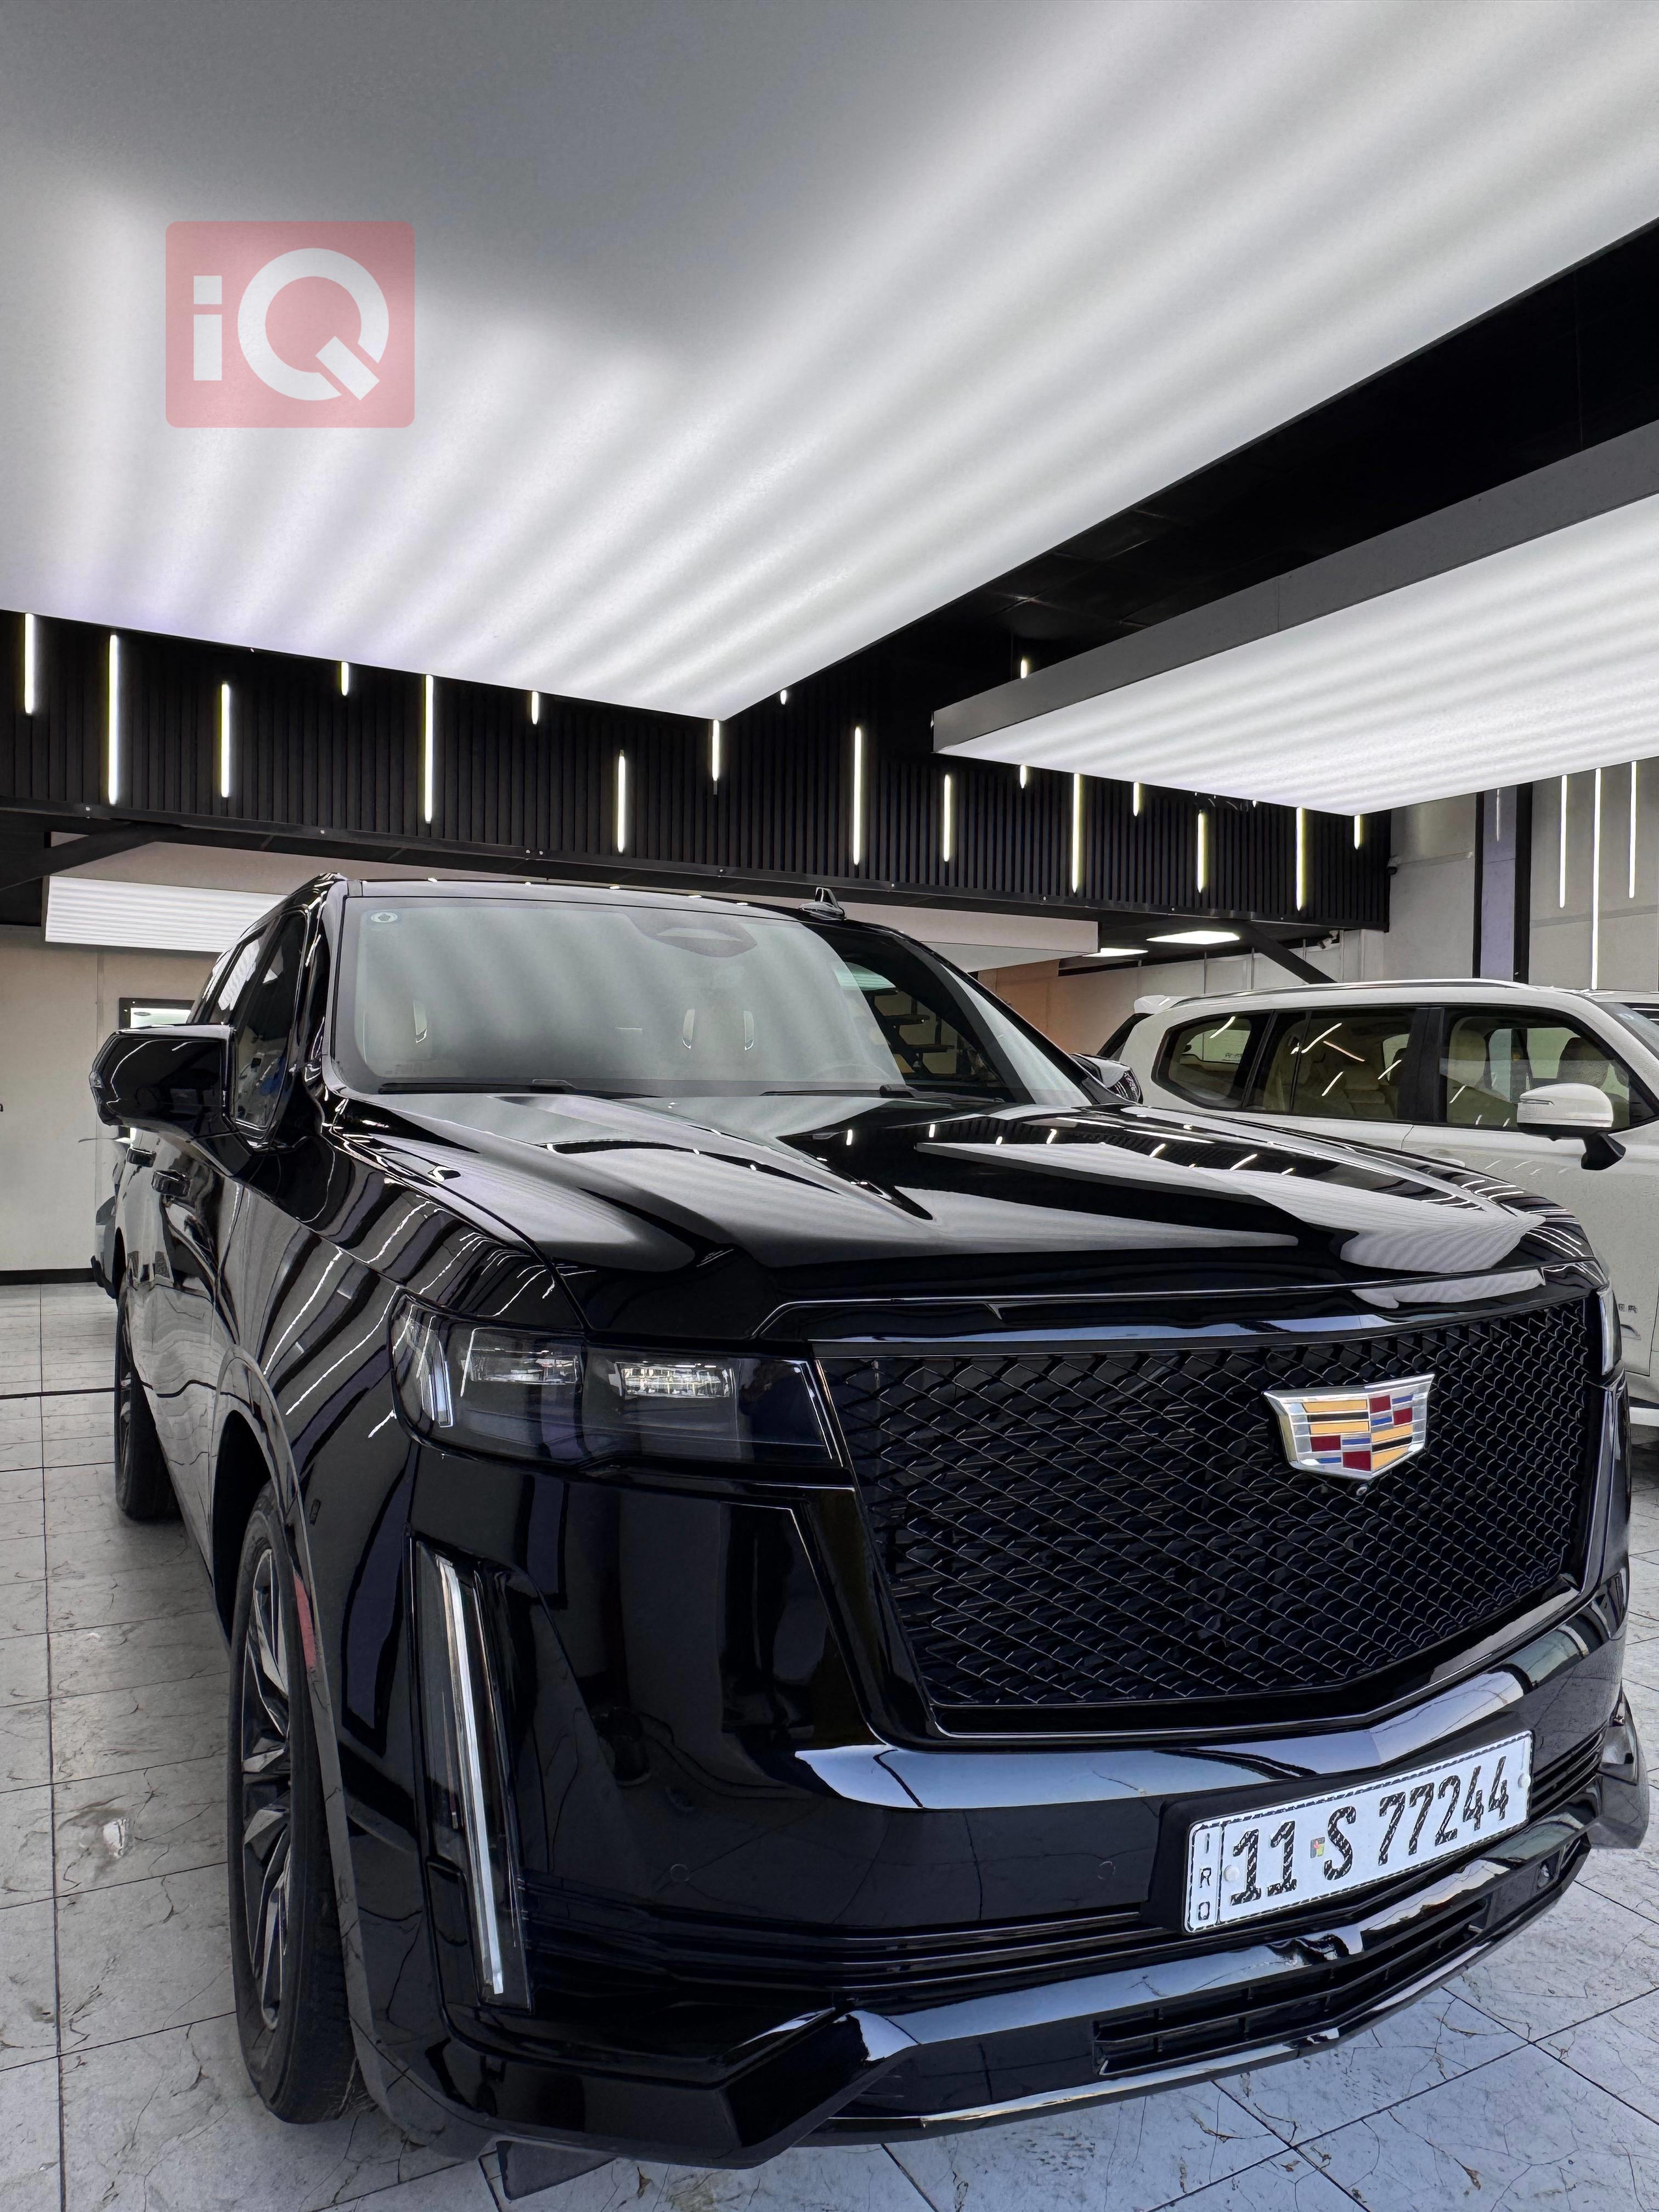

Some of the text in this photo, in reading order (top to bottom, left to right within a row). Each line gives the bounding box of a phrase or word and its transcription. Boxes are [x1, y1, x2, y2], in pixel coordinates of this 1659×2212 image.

[1229, 1756, 1509, 1906] 11 S 77244
